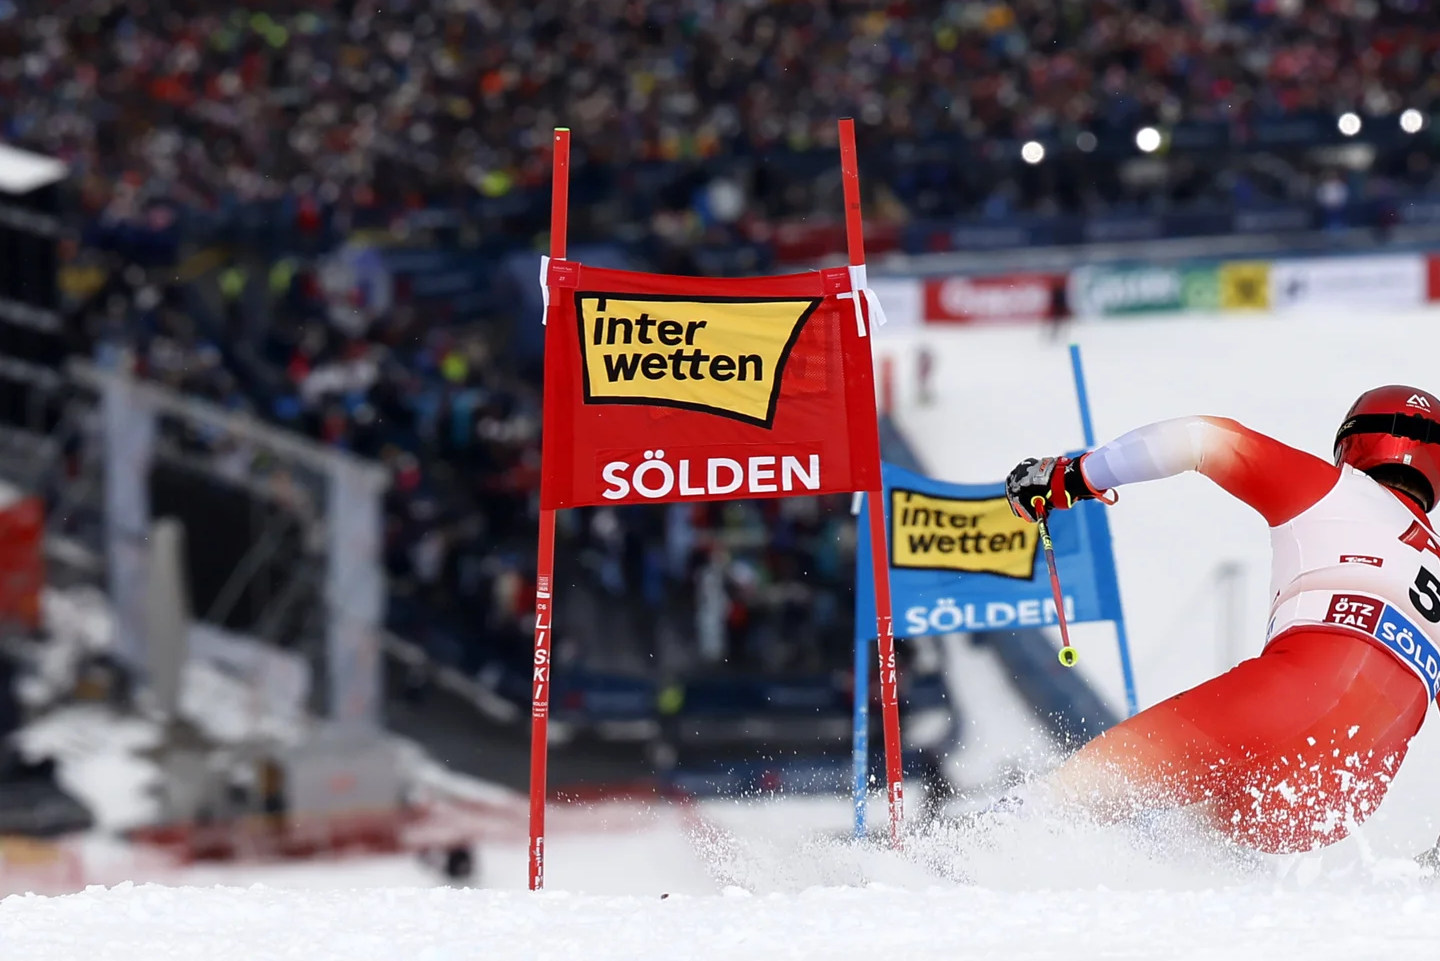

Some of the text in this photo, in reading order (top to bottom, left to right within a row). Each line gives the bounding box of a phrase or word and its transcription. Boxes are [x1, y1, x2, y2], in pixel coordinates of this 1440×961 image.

[593, 308, 707, 346] inter
[603, 348, 763, 382] wetten
[601, 449, 821, 500] SÖLDEN
[902, 501, 983, 529] inter
[908, 529, 1027, 554] wetten
[905, 598, 1075, 635] SÖLDEN
[1332, 613, 1369, 629] TAL
[1335, 597, 1375, 617] ÖTZ
[533, 613, 548, 700] LISKI
